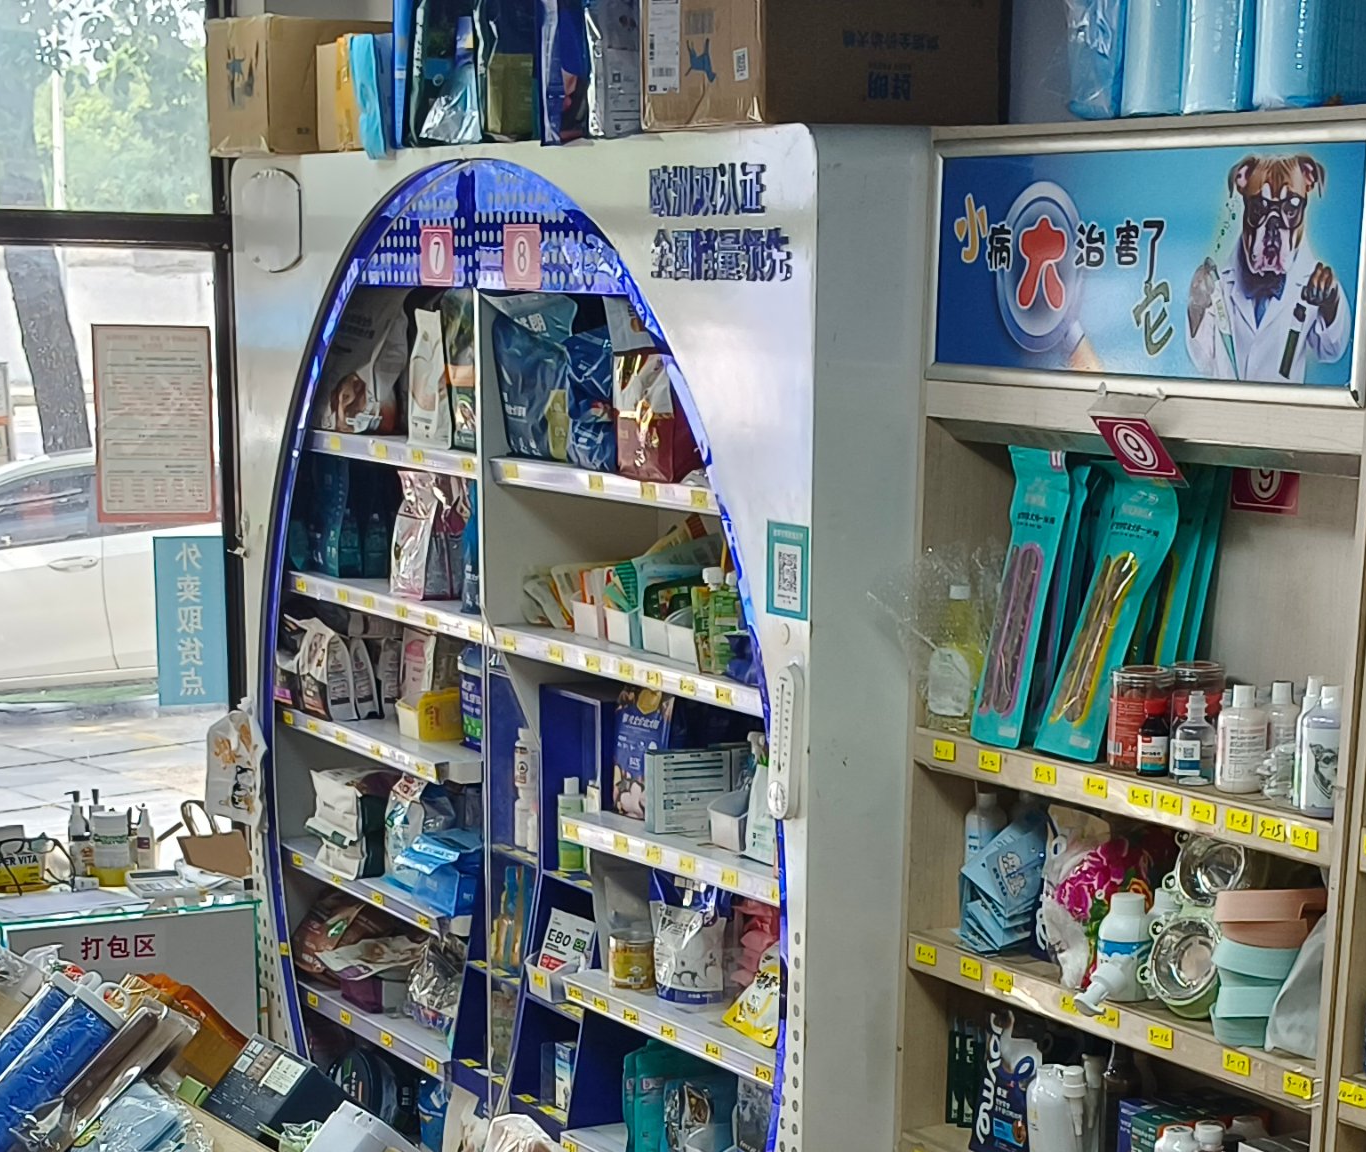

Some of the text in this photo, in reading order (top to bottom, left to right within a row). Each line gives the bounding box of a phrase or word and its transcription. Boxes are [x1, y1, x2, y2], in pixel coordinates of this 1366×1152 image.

[18, 855, 39, 865] VITA
[81, 934, 156, 960] 打包区
